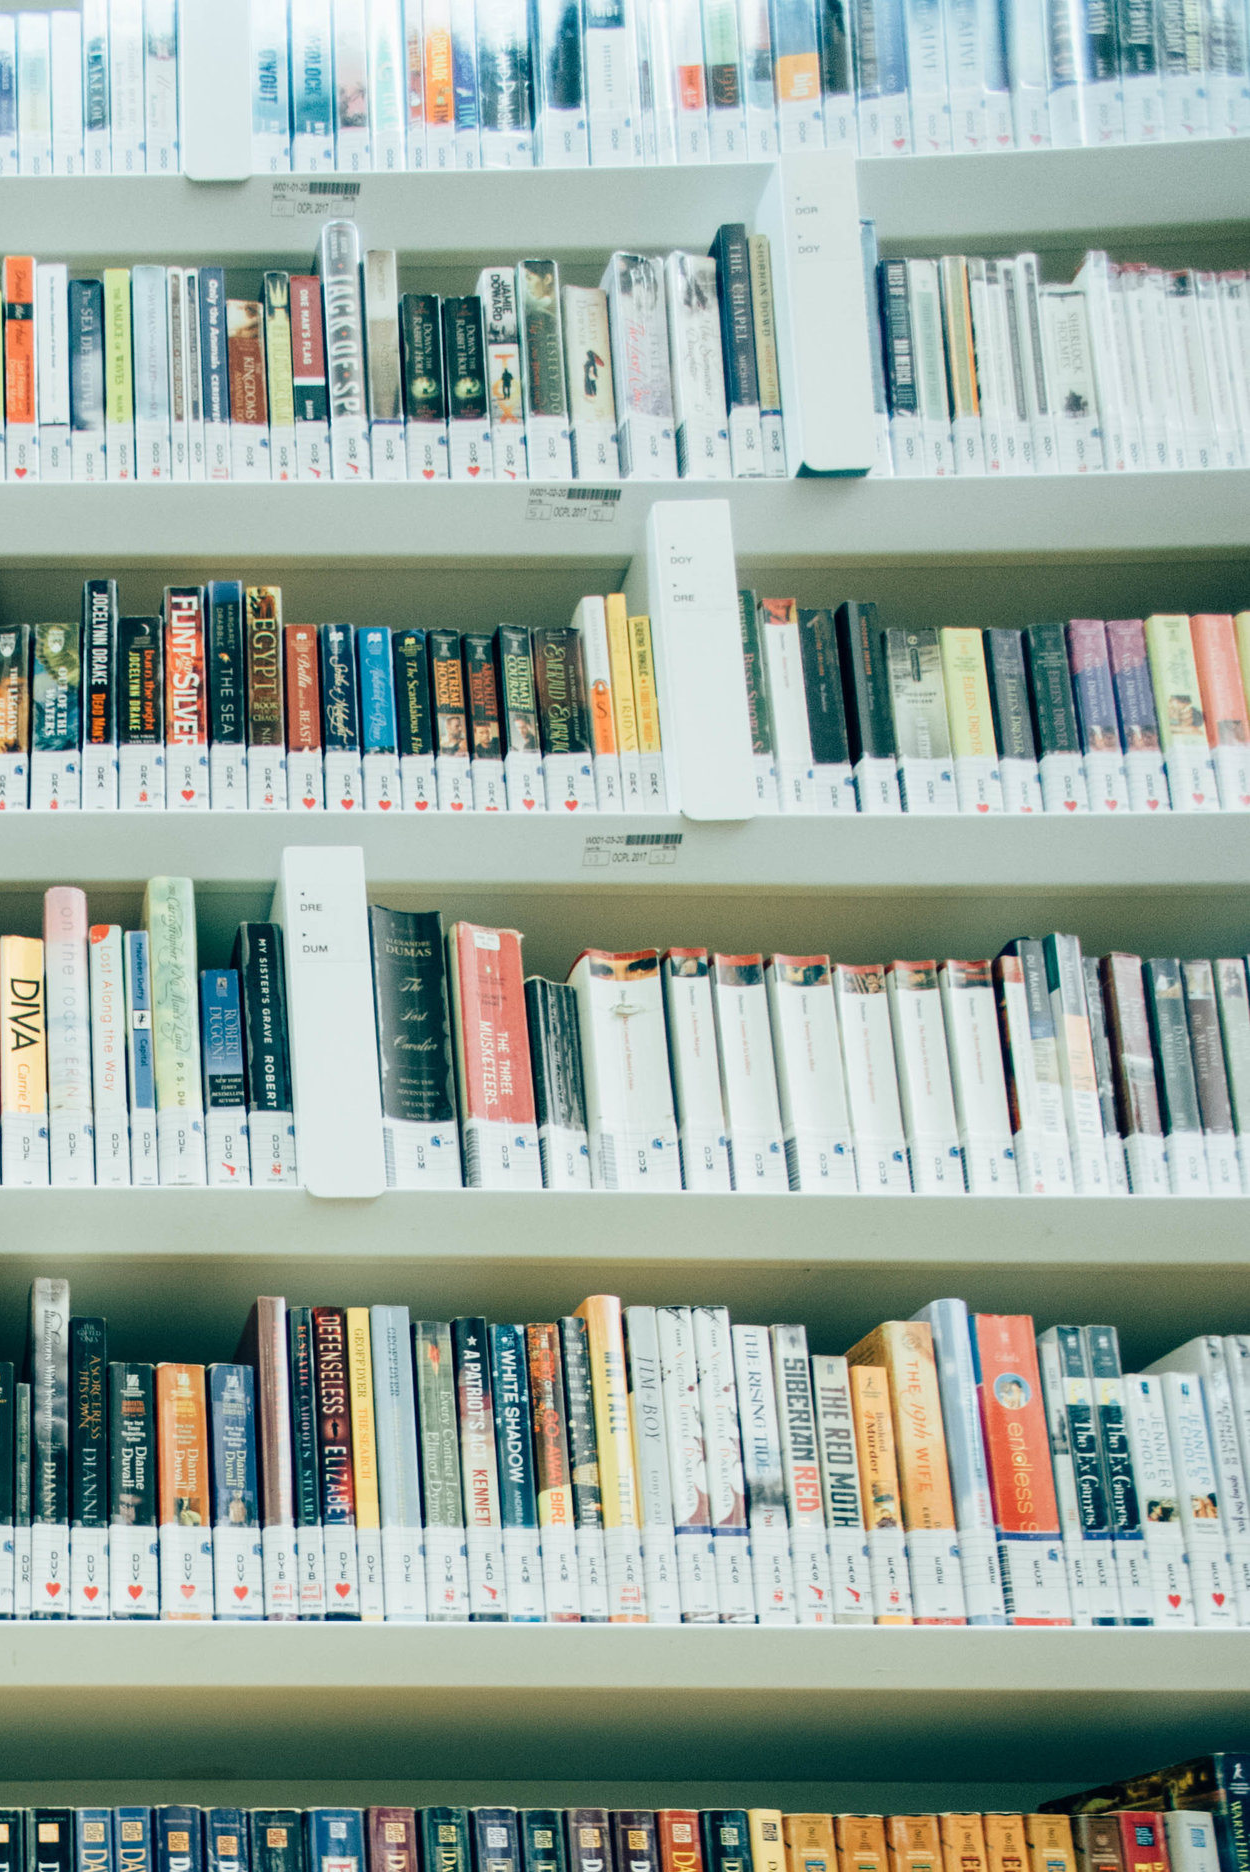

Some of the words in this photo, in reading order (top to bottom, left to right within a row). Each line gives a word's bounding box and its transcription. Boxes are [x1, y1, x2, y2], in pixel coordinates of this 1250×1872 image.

[798, 245, 820, 254] DOY
[491, 274, 502, 321] DOWARD
[501, 282, 512, 316] JAMIE
[92, 592, 110, 646] JOCELYNN
[171, 596, 197, 655] FLINT
[92, 649, 106, 685] DRAKE
[173, 673, 198, 745] SILVER
[301, 904, 323, 912] DRE
[258, 938, 268, 953] MY
[303, 945, 328, 953] DUM
[384, 945, 432, 956] DUMAS
[260, 955, 270, 1003] SISTER'S
[10, 978, 39, 1051] DIVA
[263, 1008, 272, 1043] GRAVE
[479, 1020, 498, 1106] MUSKETEERS
[498, 1032, 509, 1051] THE
[264, 1056, 277, 1108] ROBERT
[499, 1058, 513, 1096] THREE
[318, 1315, 345, 1415] DEFENSELESS
[501, 1351, 520, 1402] WHITE
[463, 1362, 485, 1434] PATRIOT'S
[783, 1358, 815, 1461] SIBERIAN
[821, 1385, 851, 1420] THE
[505, 1406, 524, 1483] SHADOW
[825, 1426, 853, 1467] RED
[1006, 1422, 1036, 1514] endless
[793, 1466, 821, 1512] RED
[830, 1472, 860, 1528] MOTH
